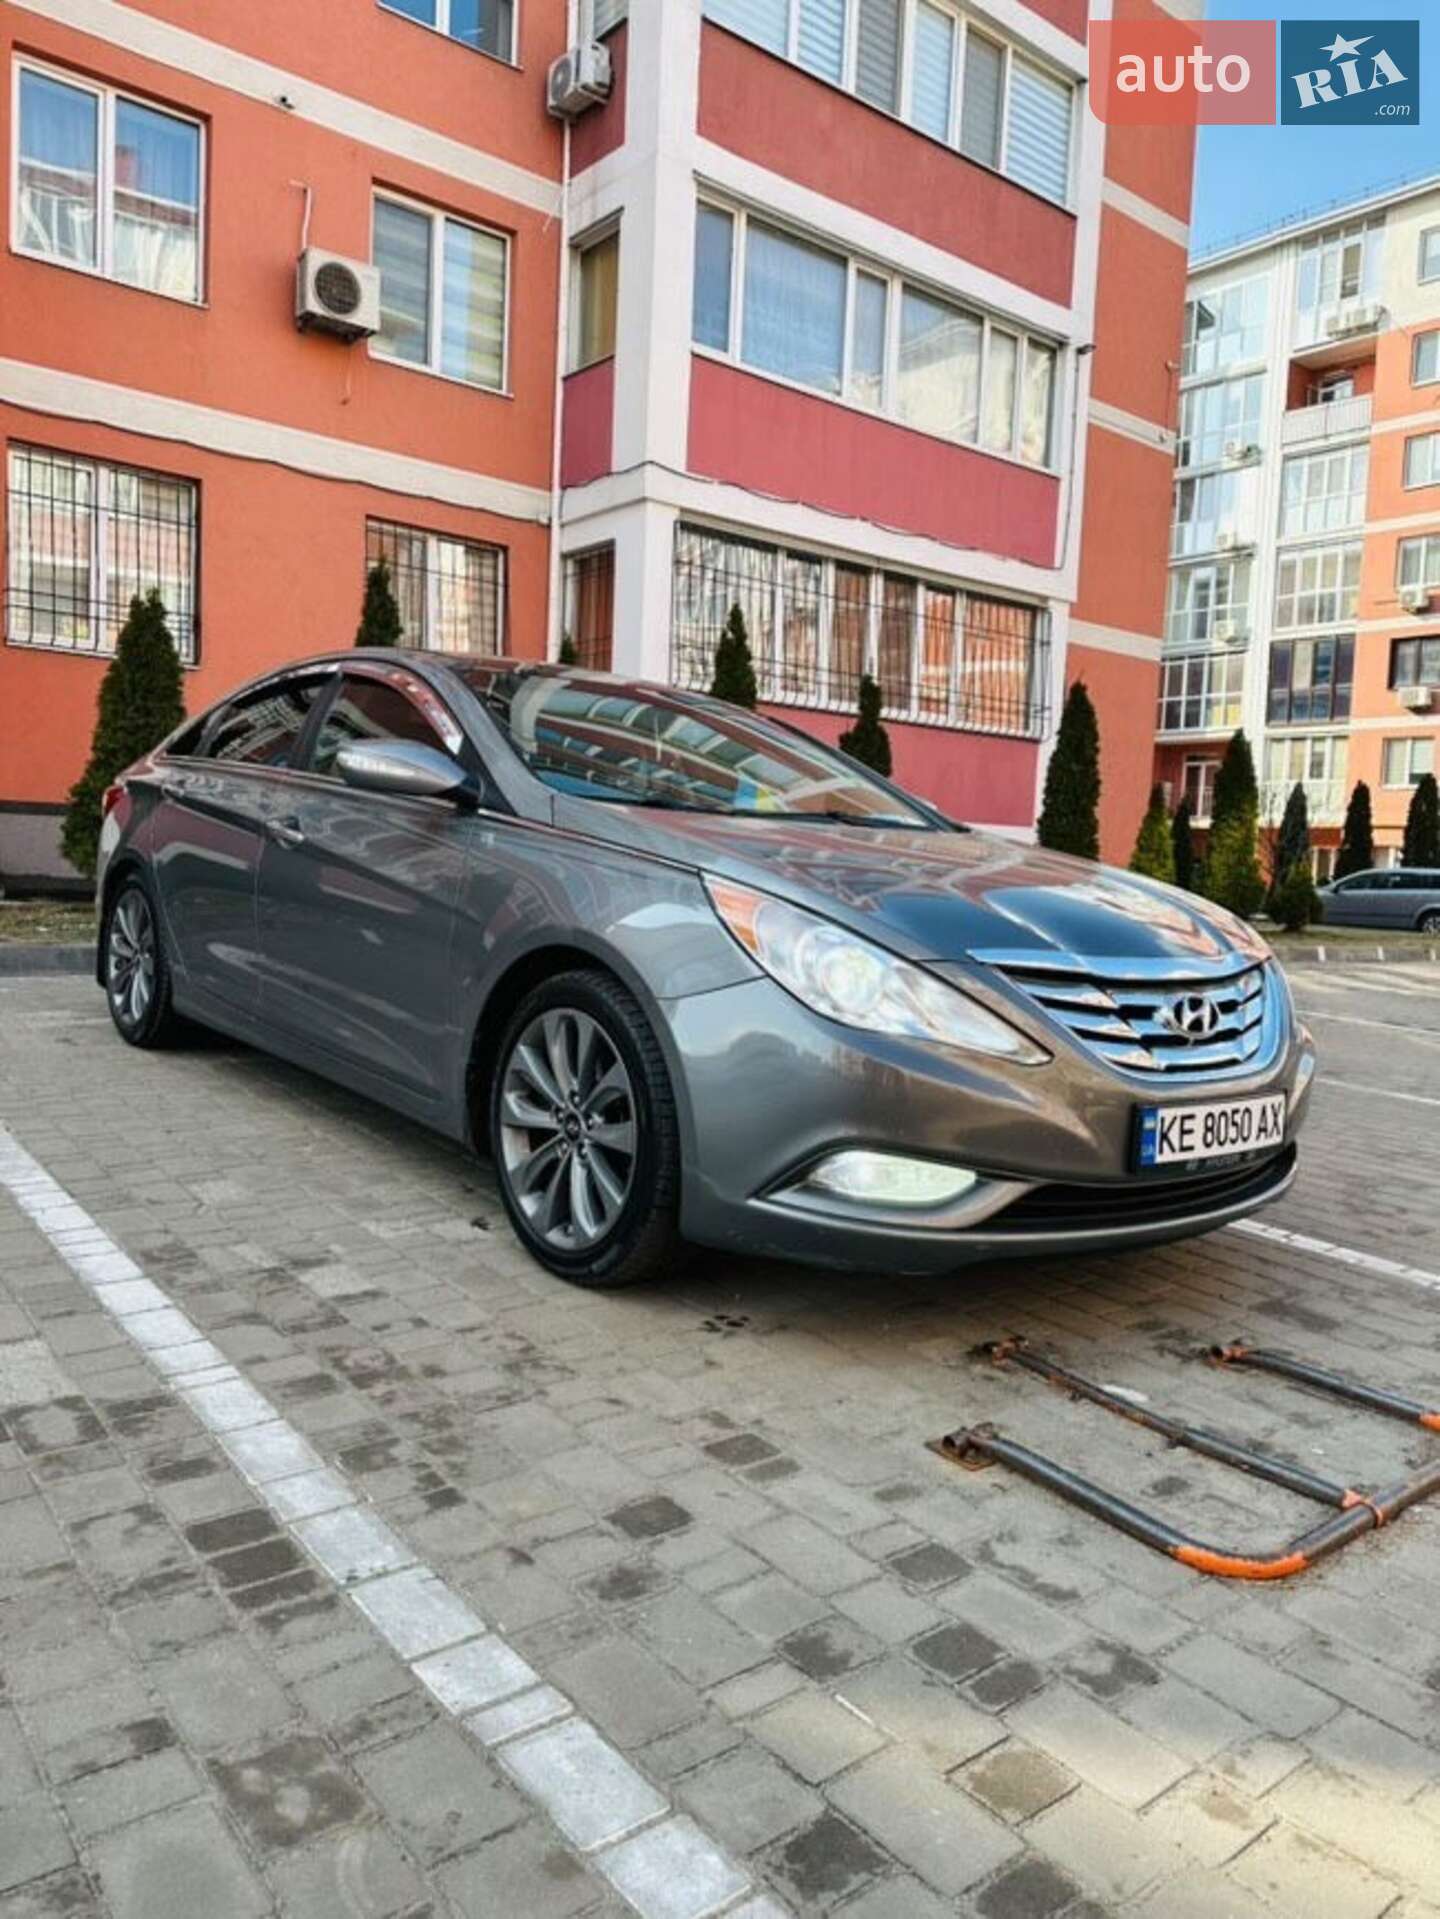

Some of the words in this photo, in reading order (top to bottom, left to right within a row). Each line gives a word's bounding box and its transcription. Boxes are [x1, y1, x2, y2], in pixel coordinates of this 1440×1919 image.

[1158, 1114, 1196, 1155] KE
[1202, 1107, 1251, 1148] 8050
[1256, 1102, 1282, 1141] AX
